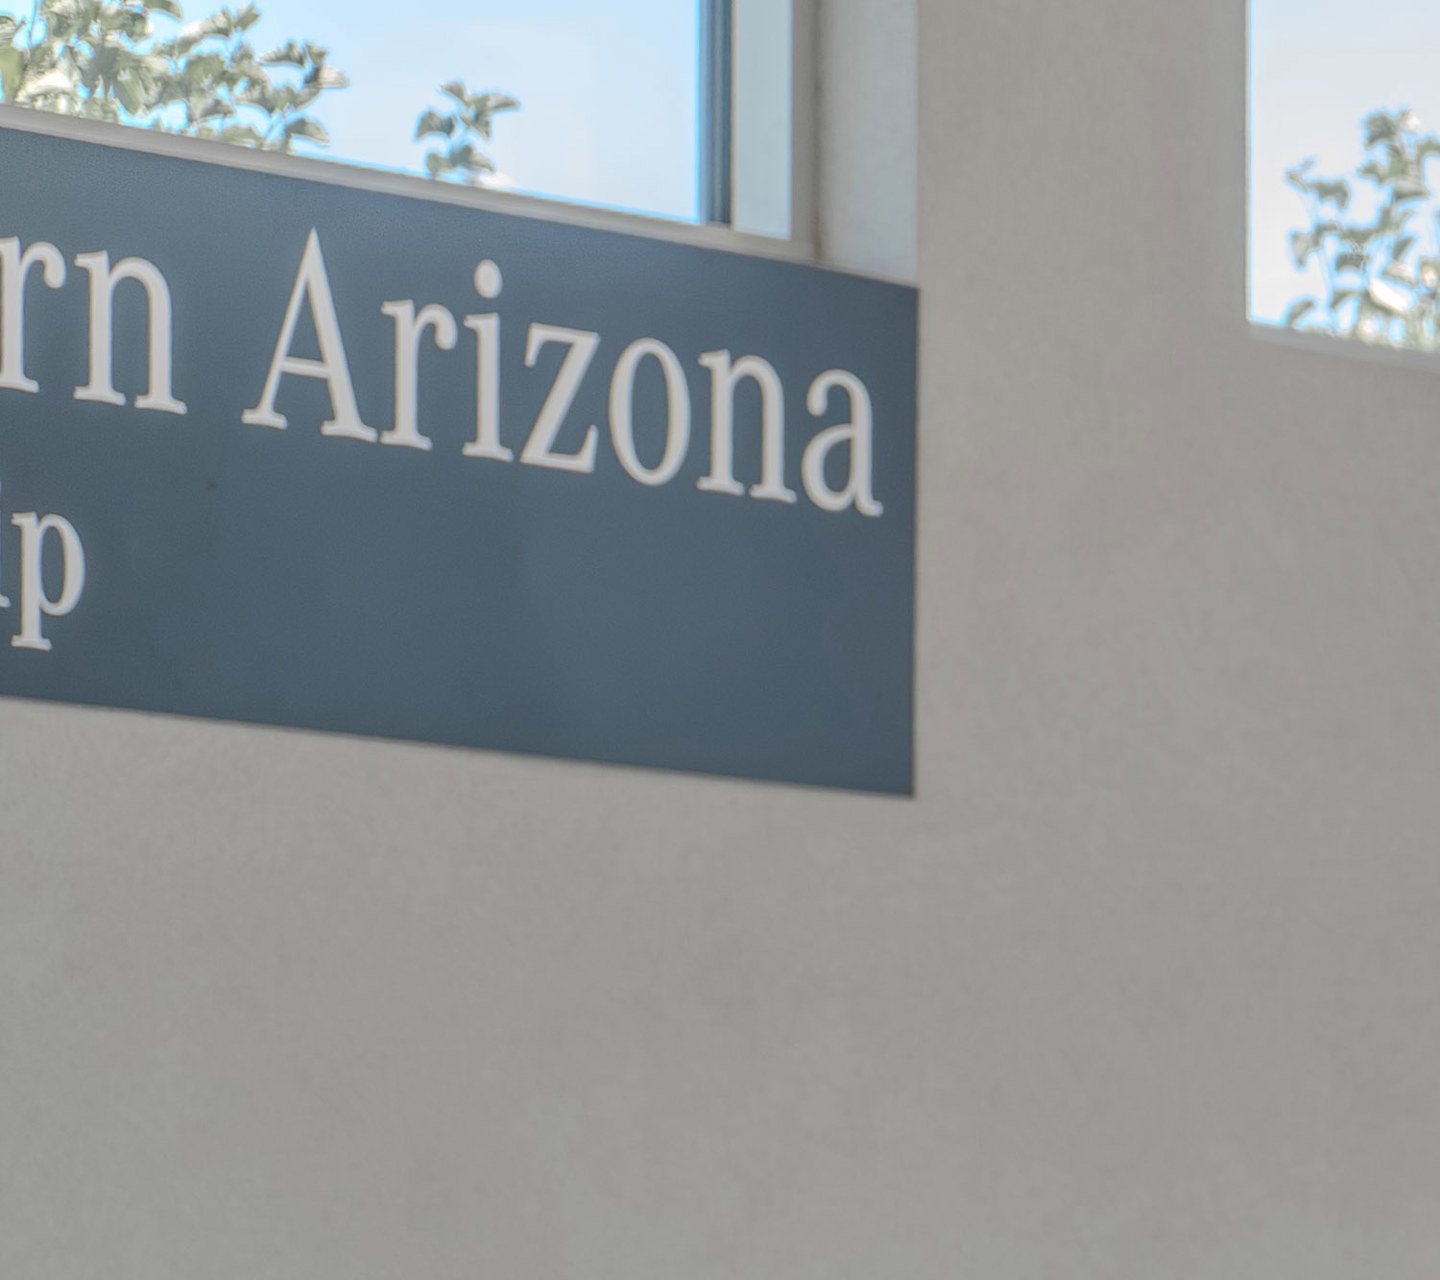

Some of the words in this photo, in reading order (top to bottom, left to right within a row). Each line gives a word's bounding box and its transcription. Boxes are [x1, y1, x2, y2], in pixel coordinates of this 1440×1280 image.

[0, 235, 188, 415] rn
[242, 227, 884, 517] Arizona
[0, 511, 86, 651] p
